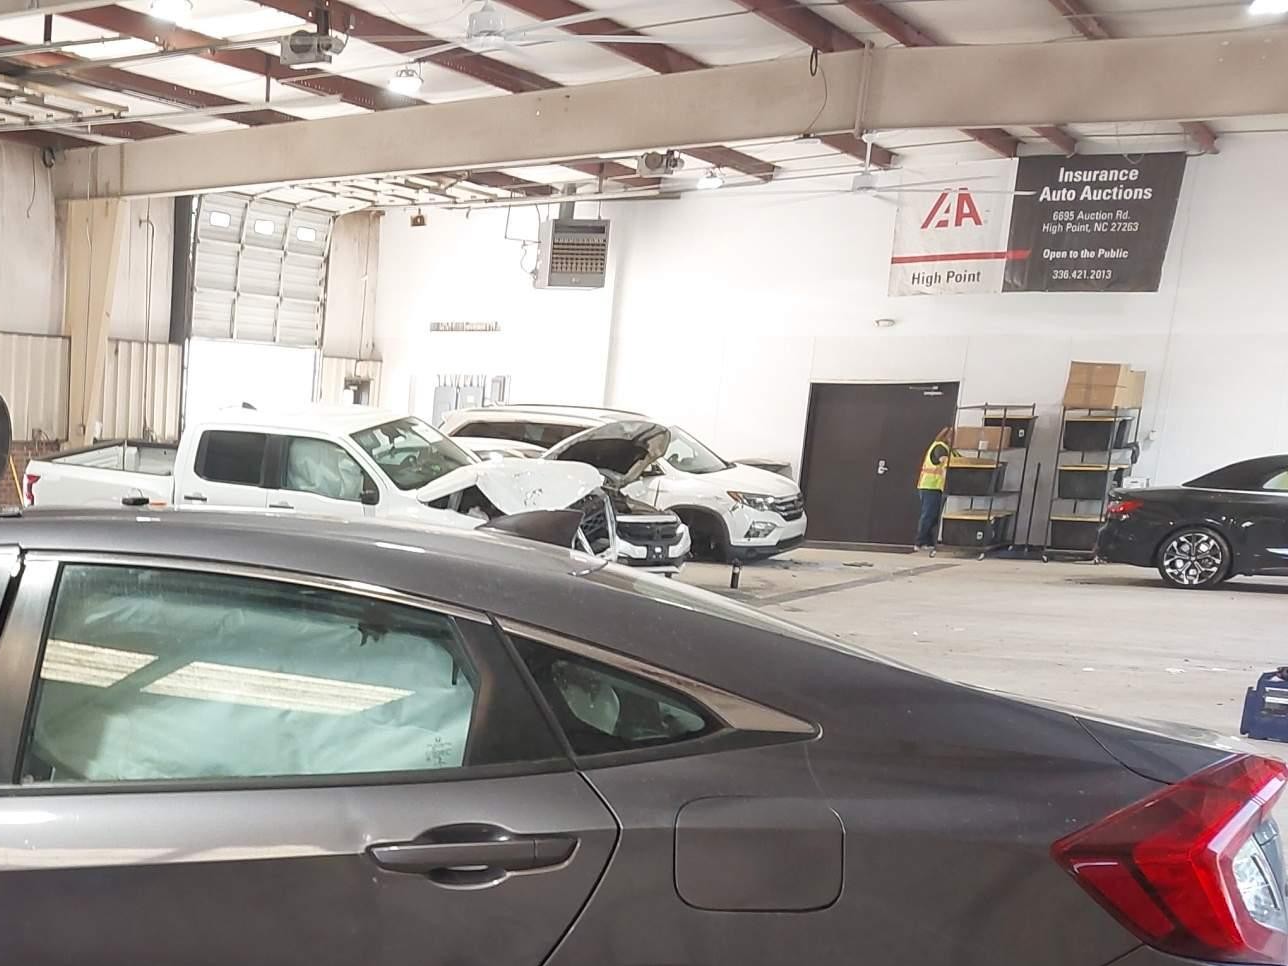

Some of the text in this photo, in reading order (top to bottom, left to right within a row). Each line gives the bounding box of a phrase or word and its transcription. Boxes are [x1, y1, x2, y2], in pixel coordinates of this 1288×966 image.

[1058, 167, 1139, 182] Insurance
[1039, 185, 1153, 202] Auto Auctions
[1052, 210, 1131, 220] 6695 Auction Rd.
[1042, 222, 1140, 234] High Point, NC 27263
[1042, 249, 1067, 261] Open
[1080, 249, 1095, 258] the
[1097, 248, 1129, 258] Public
[911, 269, 981, 287] High Point
[1052, 269, 1112, 279] 336.421.2013
